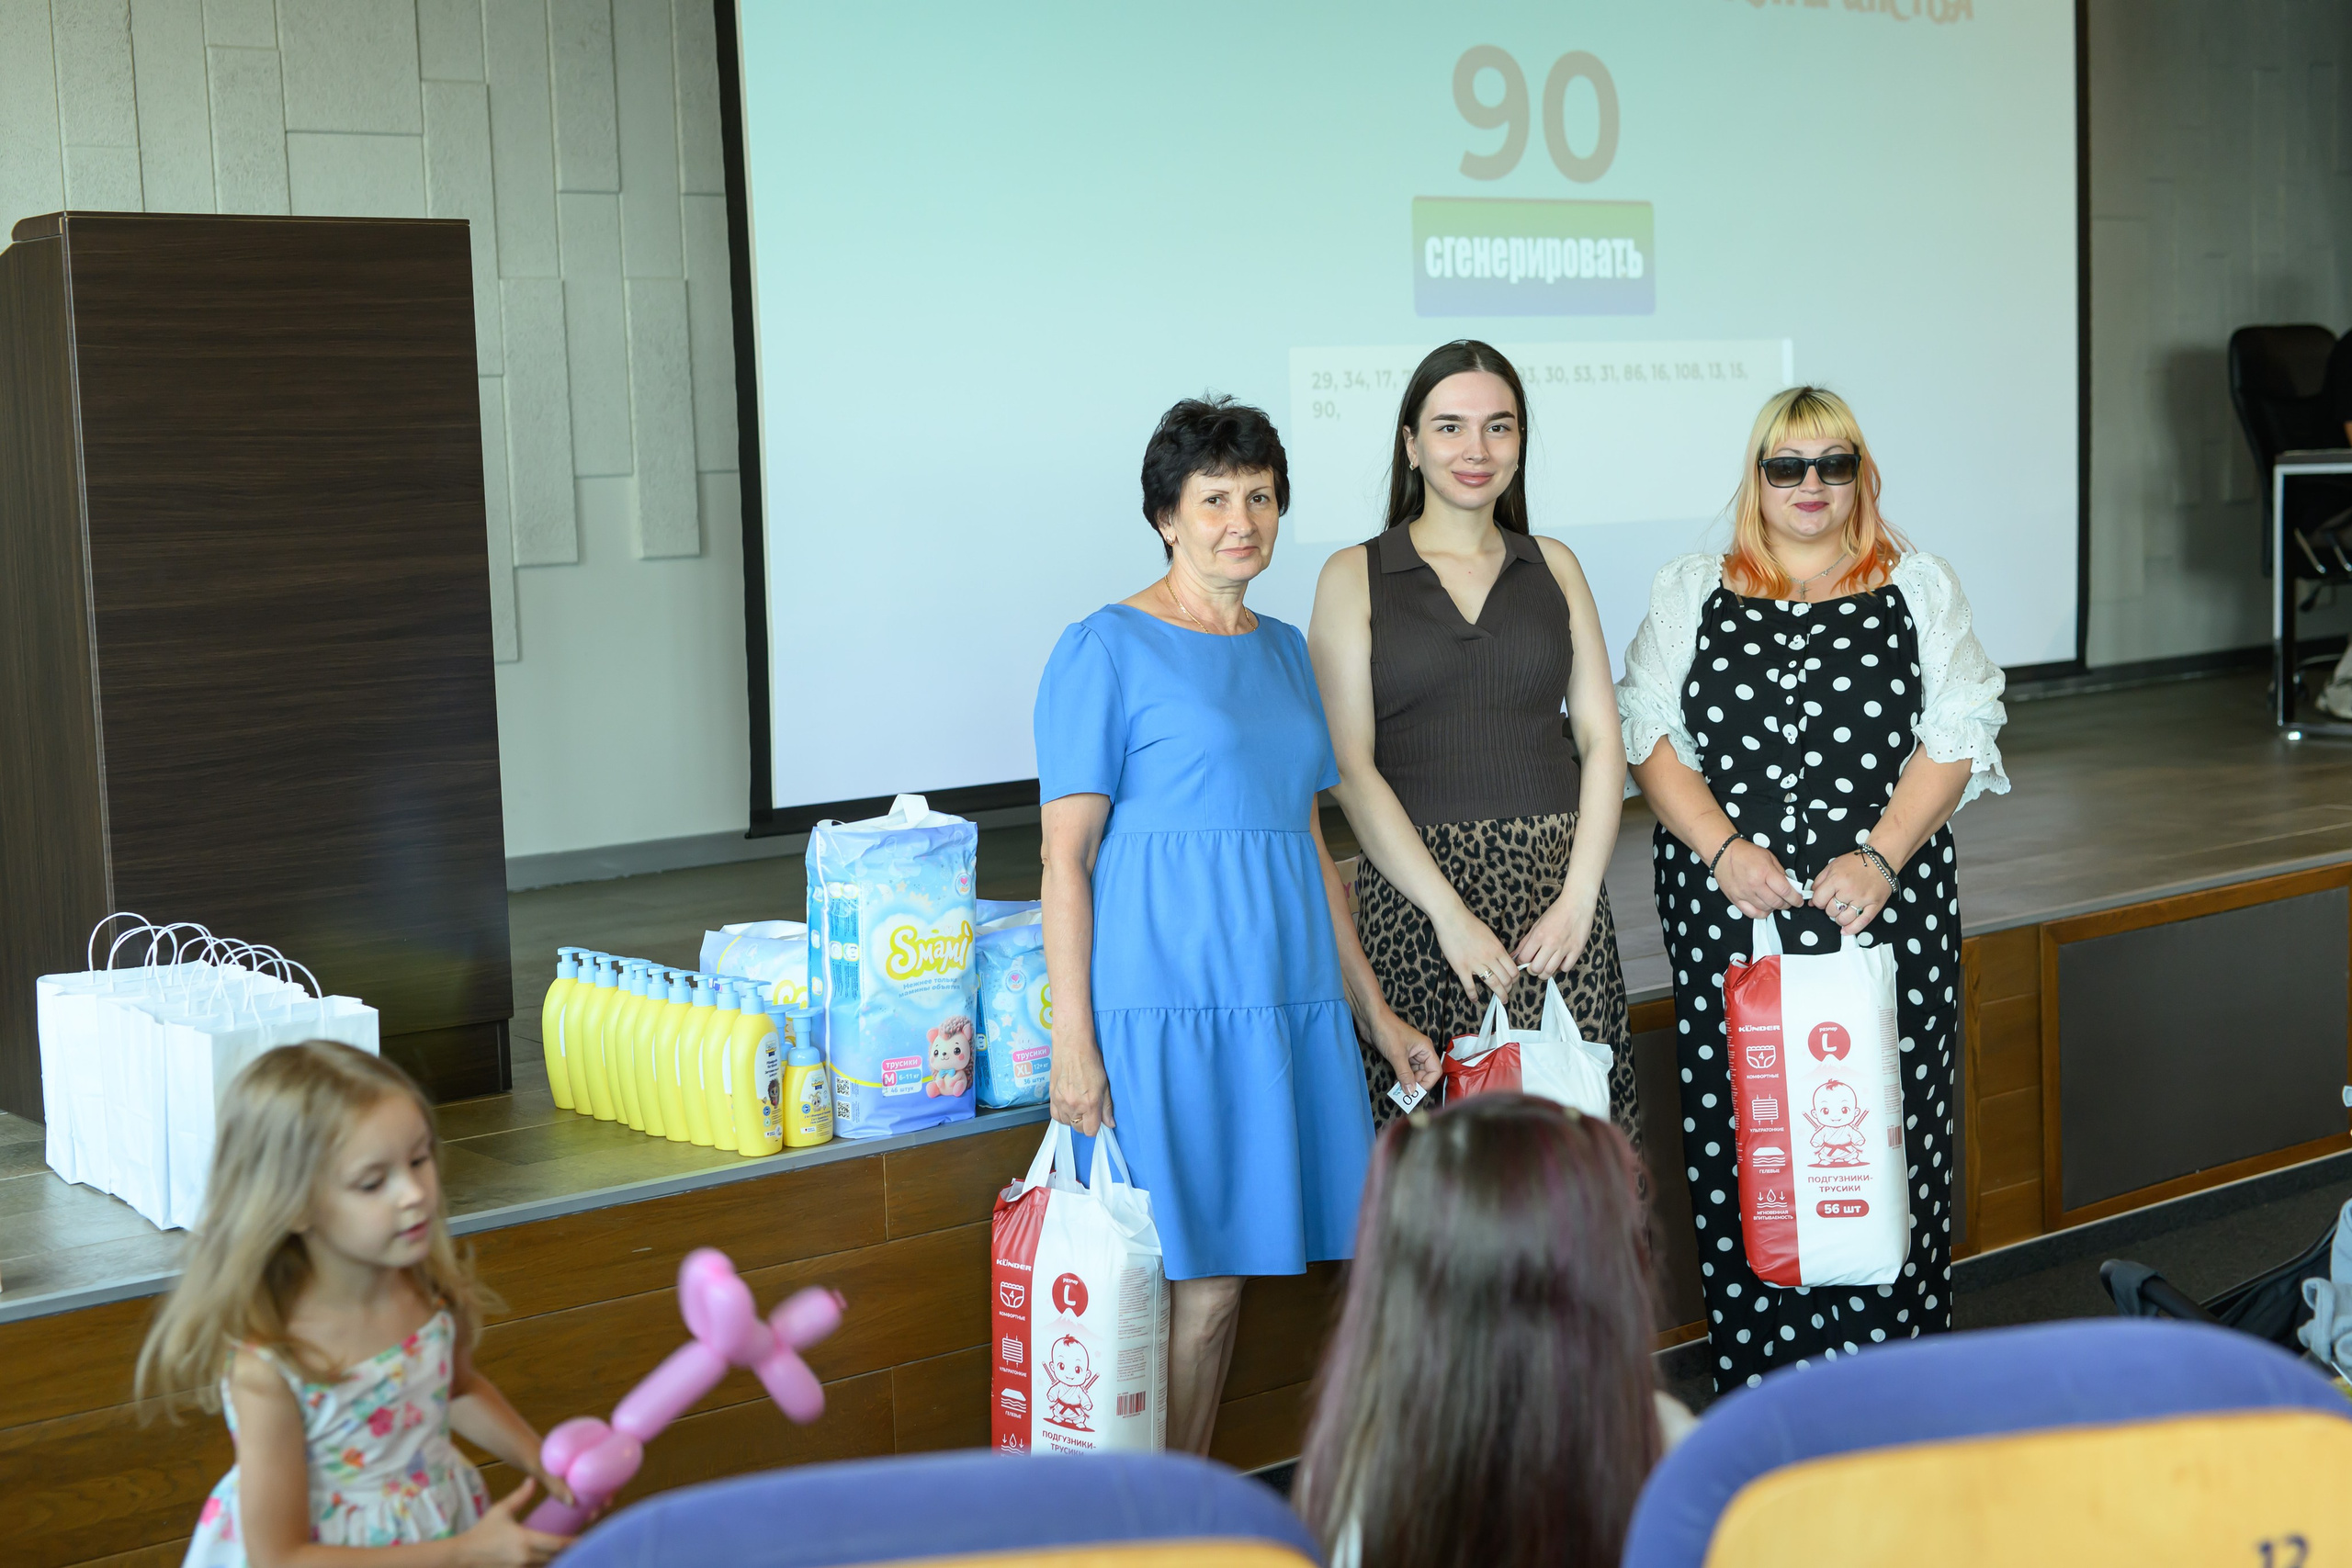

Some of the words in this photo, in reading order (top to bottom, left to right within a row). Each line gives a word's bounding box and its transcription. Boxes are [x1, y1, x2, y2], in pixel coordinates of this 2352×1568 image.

[1452, 44, 1620, 184] 90
[1424, 236, 1645, 284] сгенерировать
[1311, 371, 1339, 392] 29,
[1343, 370, 1370, 390] 34,
[1374, 370, 1396, 390] 17,
[1545, 366, 1569, 385] 30,
[1312, 400, 1340, 421] 90,
[1822, 1032, 1838, 1053] L
[1016, 1048, 1047, 1061] трусики
[1758, 1052, 1764, 1060] 4
[886, 1059, 918, 1070] трусики
[1016, 1064, 1031, 1077] XL
[884, 1073, 895, 1085] M
[1807, 1175, 1873, 1184] ПОДГУЗНИКИ-
[1819, 1185, 1861, 1193] ТРУСИКИ
[1824, 1203, 1840, 1214] 56
[1843, 1205, 1862, 1213] шт
[1010, 1291, 1015, 1299] 4
[1064, 1285, 1077, 1306] L
[1042, 1430, 1097, 1450] ПОДГУЗНИКИ-
